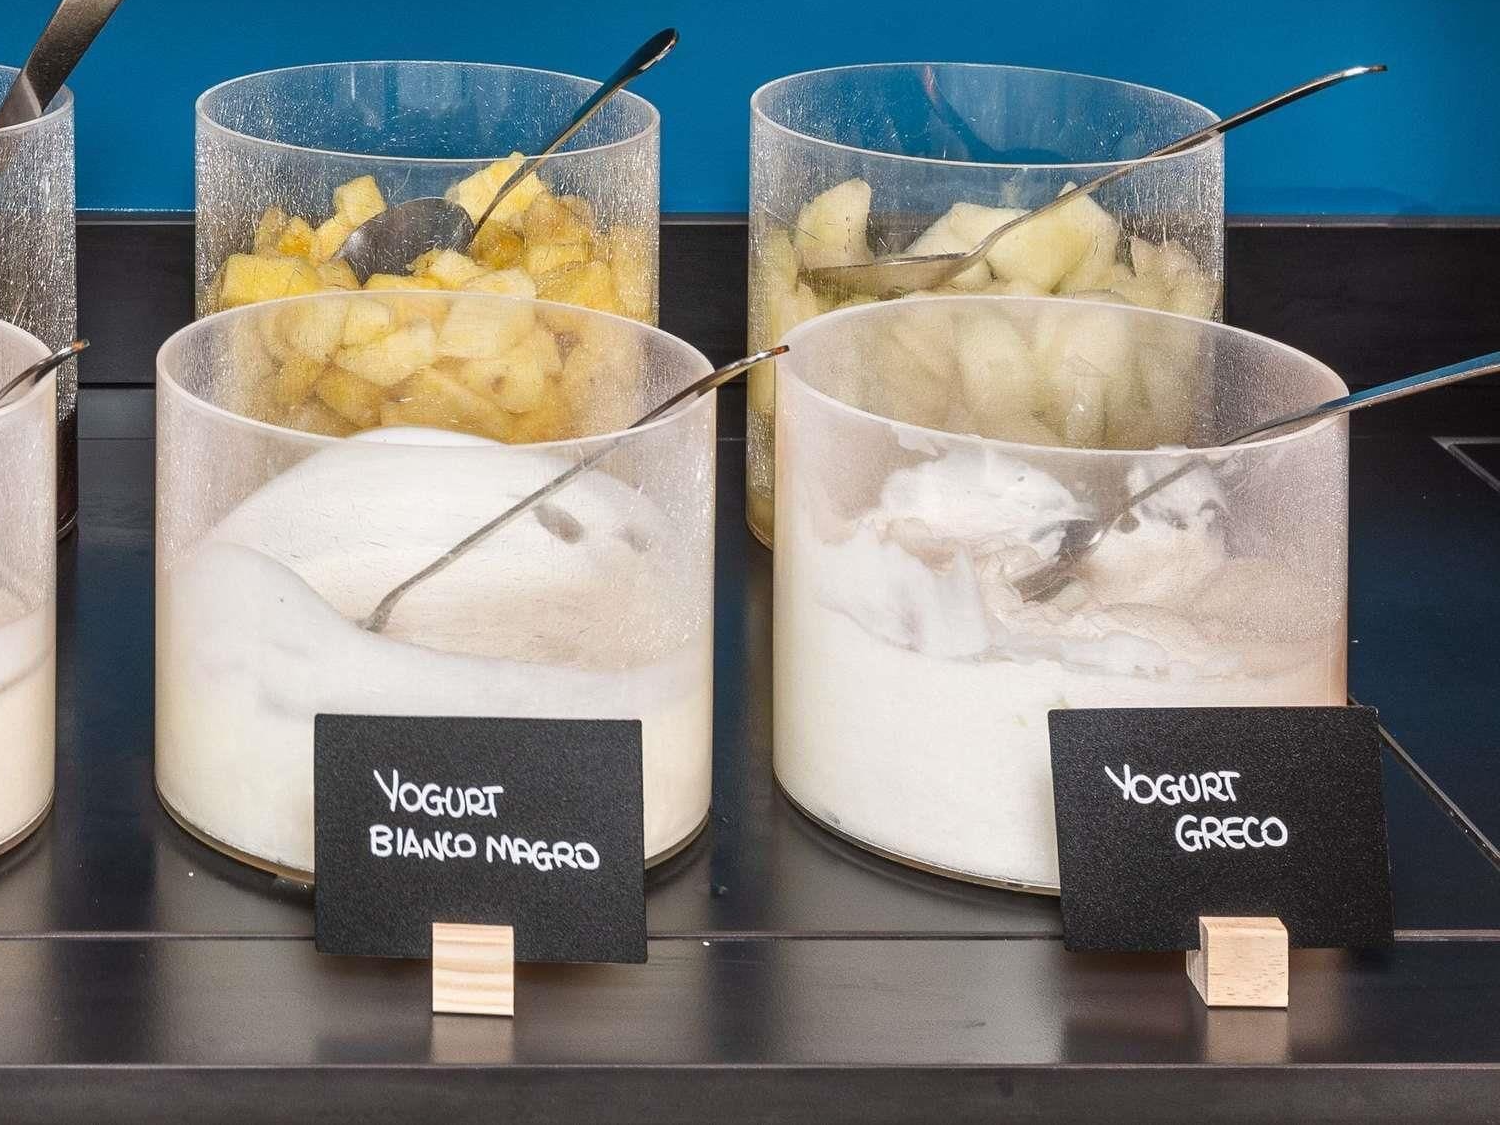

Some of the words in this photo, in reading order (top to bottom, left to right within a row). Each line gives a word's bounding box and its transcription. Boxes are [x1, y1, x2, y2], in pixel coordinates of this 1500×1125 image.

[374, 769, 506, 820] YOGURT
[1105, 764, 1242, 807] YOGURT
[369, 824, 478, 863] BIANCO
[486, 835, 602, 873] MAGRO
[1175, 815, 1290, 854] GRECO
